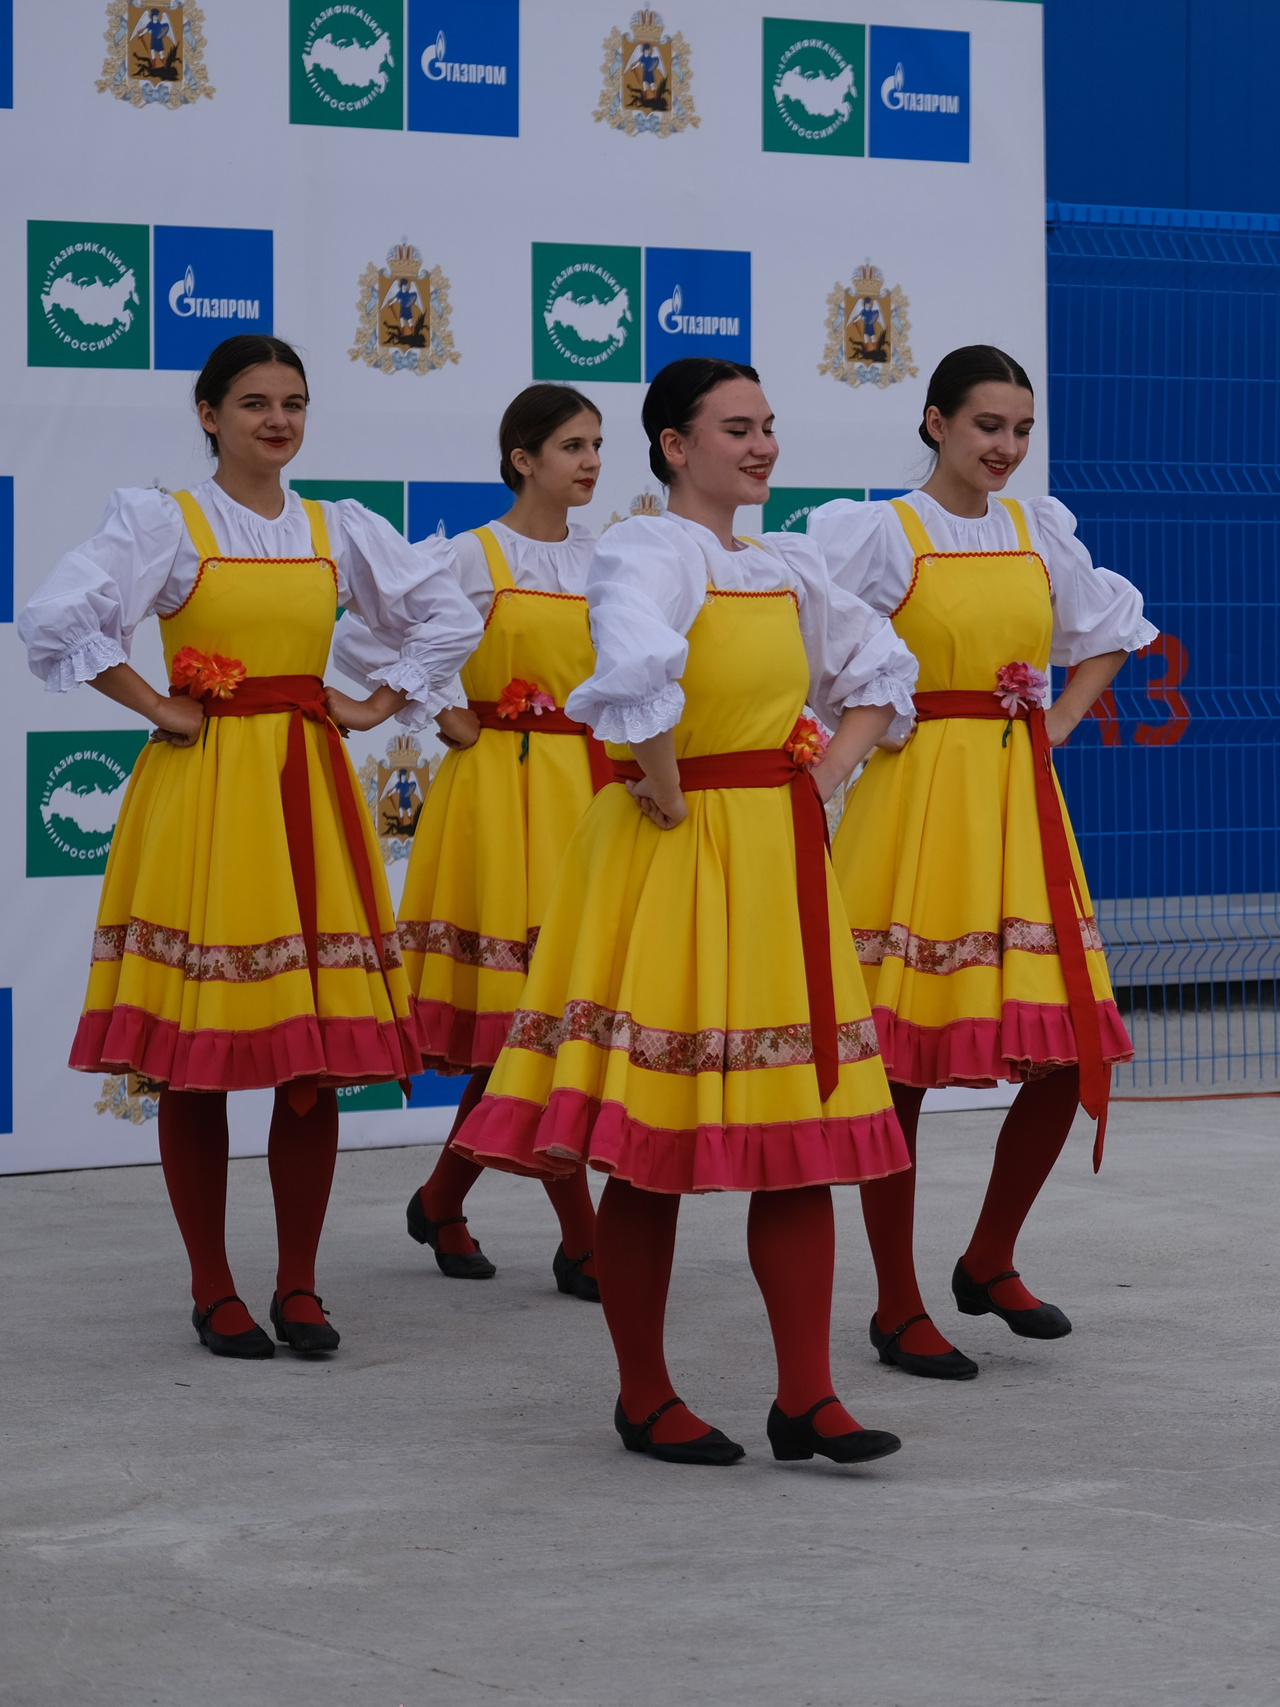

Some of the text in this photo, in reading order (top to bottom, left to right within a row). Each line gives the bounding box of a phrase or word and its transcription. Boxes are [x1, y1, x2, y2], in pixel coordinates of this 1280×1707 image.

[310, 4, 383, 37] ГАЗИФИКАЦИЯ
[781, 39, 847, 69] ГАЗИФИКАЦИЯ
[446, 62, 507, 85] ГАЗПРОМ
[903, 92, 960, 114] ГАЗПРОМ
[49, 242, 127, 274] ГАЗИФИКАЦИЯ
[551, 263, 622, 293] ГАЗИФИКАЦИЯ
[196, 297, 260, 320] ГАЗПРОМ
[682, 315, 739, 336] ГАЗПРОМ
[49, 750, 126, 781] ГАЗИФИКАЦИЯ
